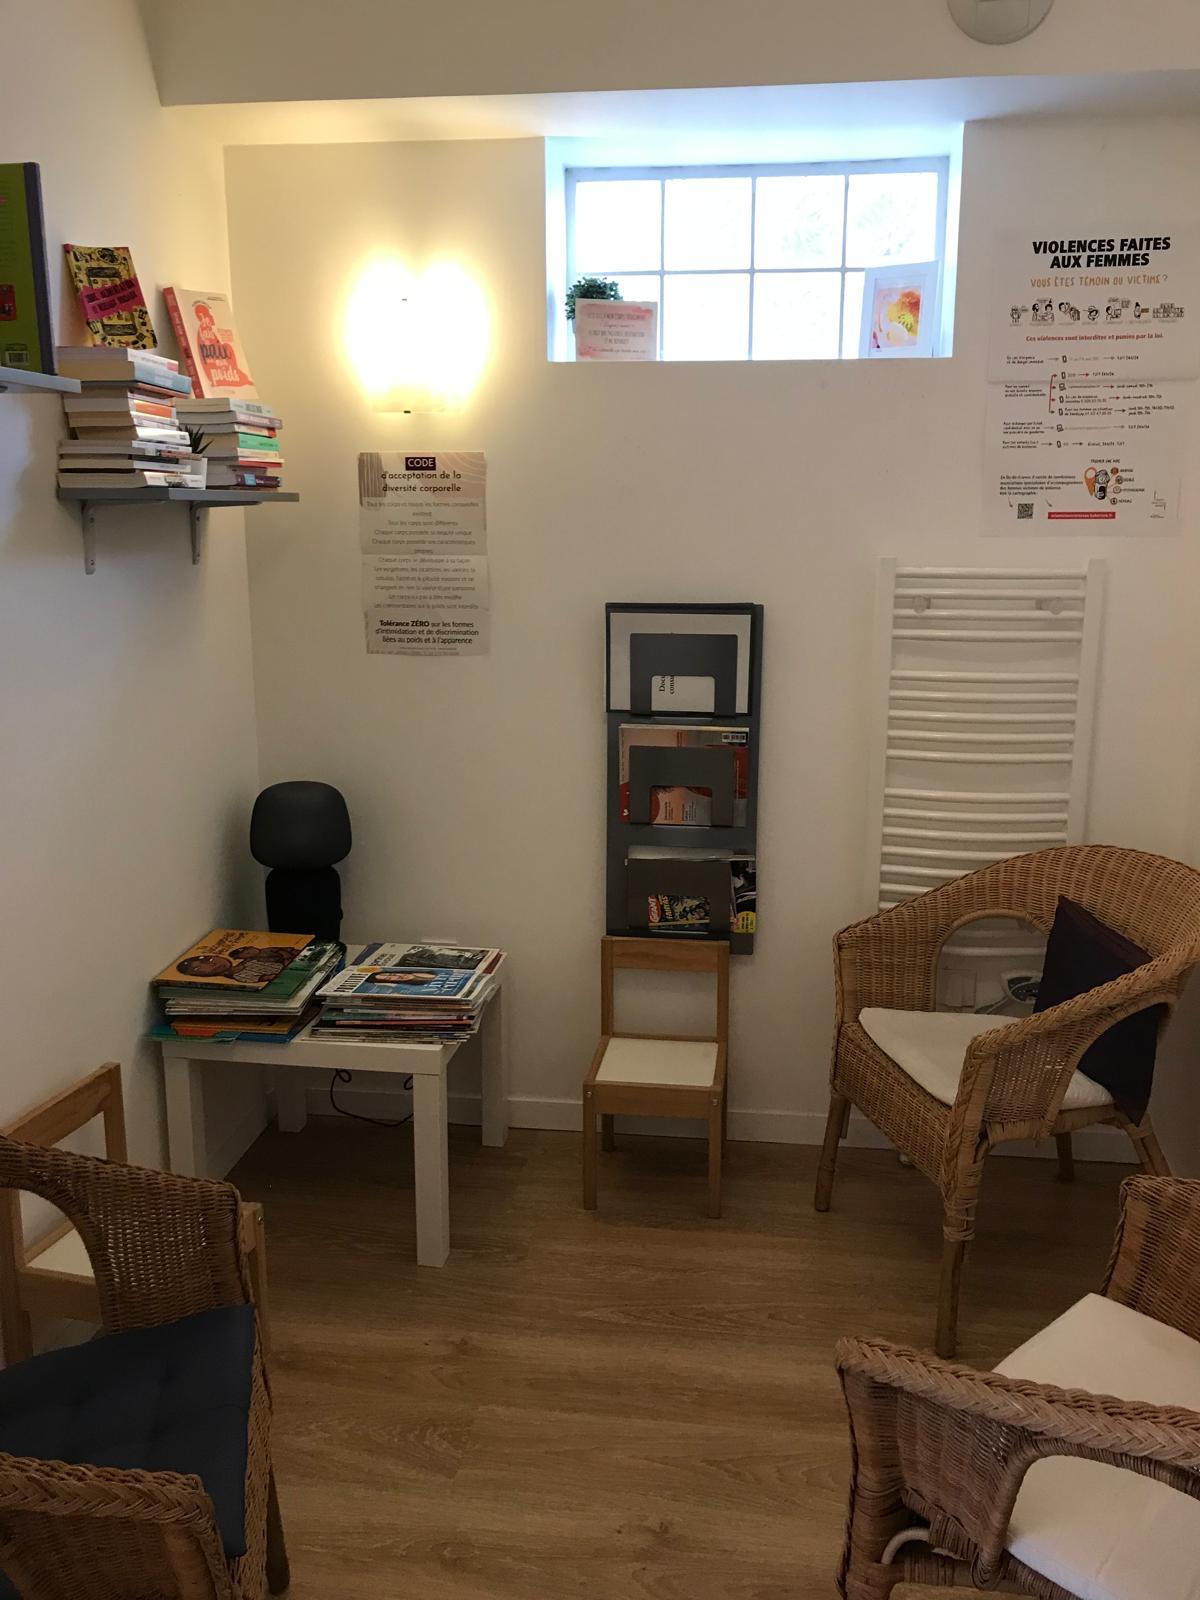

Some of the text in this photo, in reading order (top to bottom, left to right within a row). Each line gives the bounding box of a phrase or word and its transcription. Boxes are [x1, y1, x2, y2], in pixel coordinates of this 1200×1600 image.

[1033, 237, 1170, 254] VIOLENCES FAITES
[1050, 253, 1150, 268] AUX FEMMES
[1031, 277, 1051, 288] VOUS
[1113, 276, 1123, 285] OU
[407, 458, 435, 467] CODE
[381, 470, 462, 481] d'acceptation de la
[382, 483, 462, 494] diversité corporelle
[411, 619, 430, 627] ZÉRO
[407, 636, 423, 644] poids
